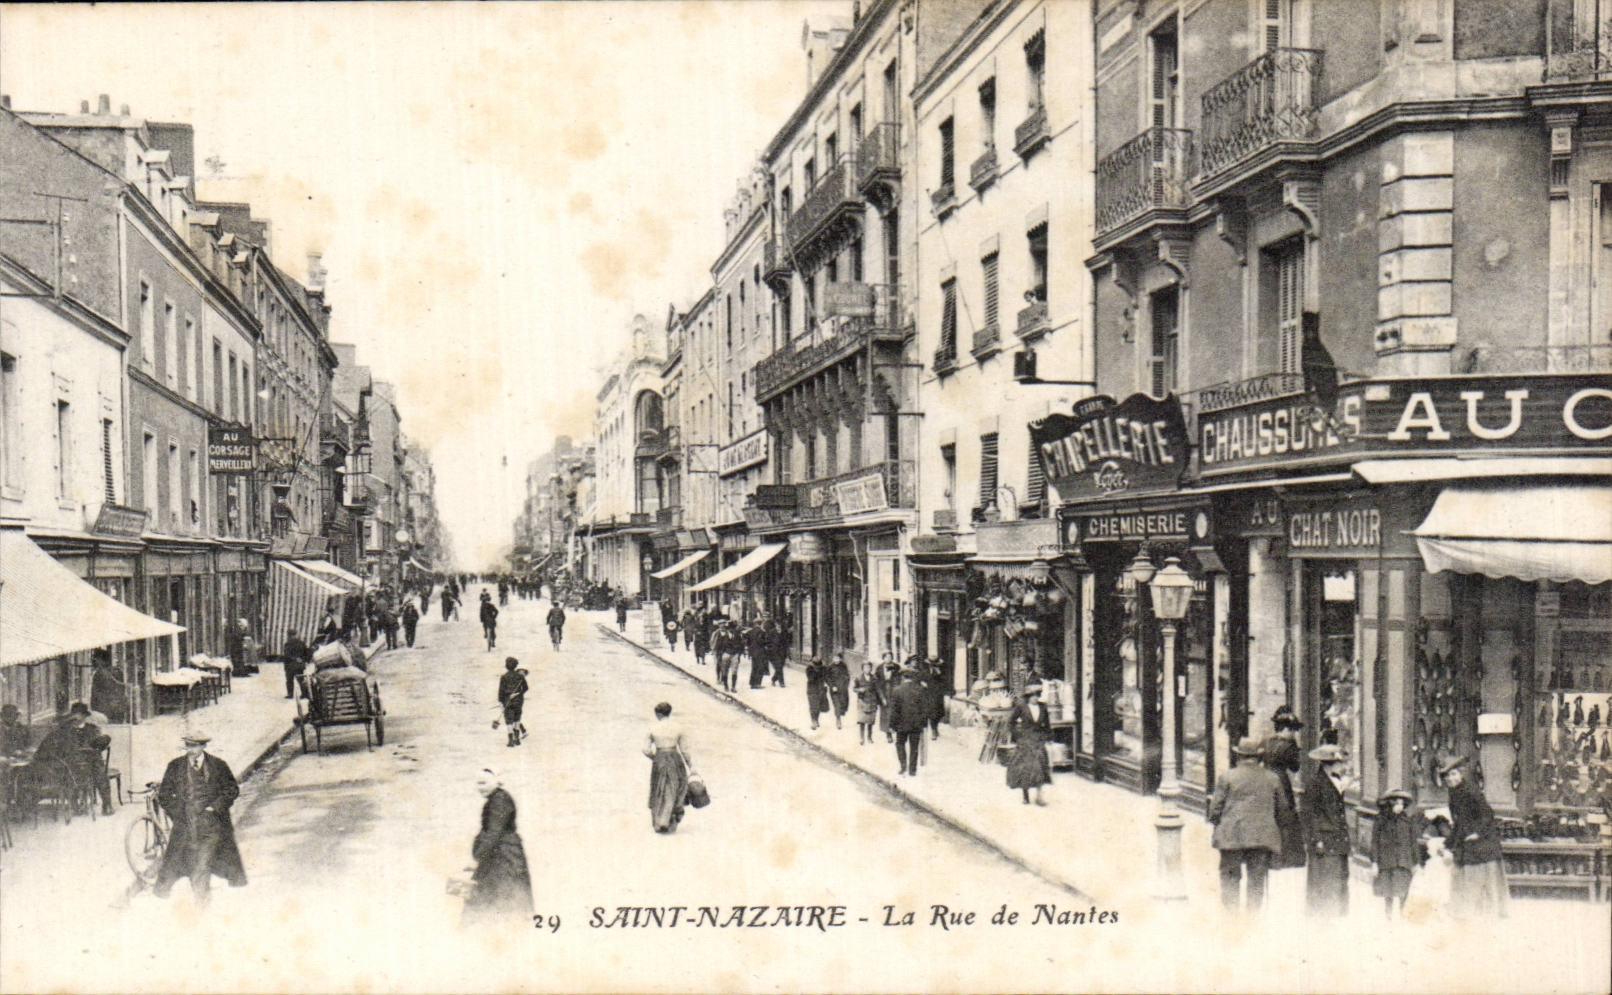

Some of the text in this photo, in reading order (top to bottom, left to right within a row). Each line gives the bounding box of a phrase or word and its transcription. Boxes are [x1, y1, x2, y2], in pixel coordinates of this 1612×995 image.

[1387, 388, 1530, 441] AU
[208, 444, 251, 457] CORSAGE
[222, 432, 239, 441] AU
[1040, 416, 1175, 479] CHAPELLERIE
[1088, 512, 1187, 537] CHEMISERIE
[1250, 500, 1382, 547] AU CHAT NOIR
